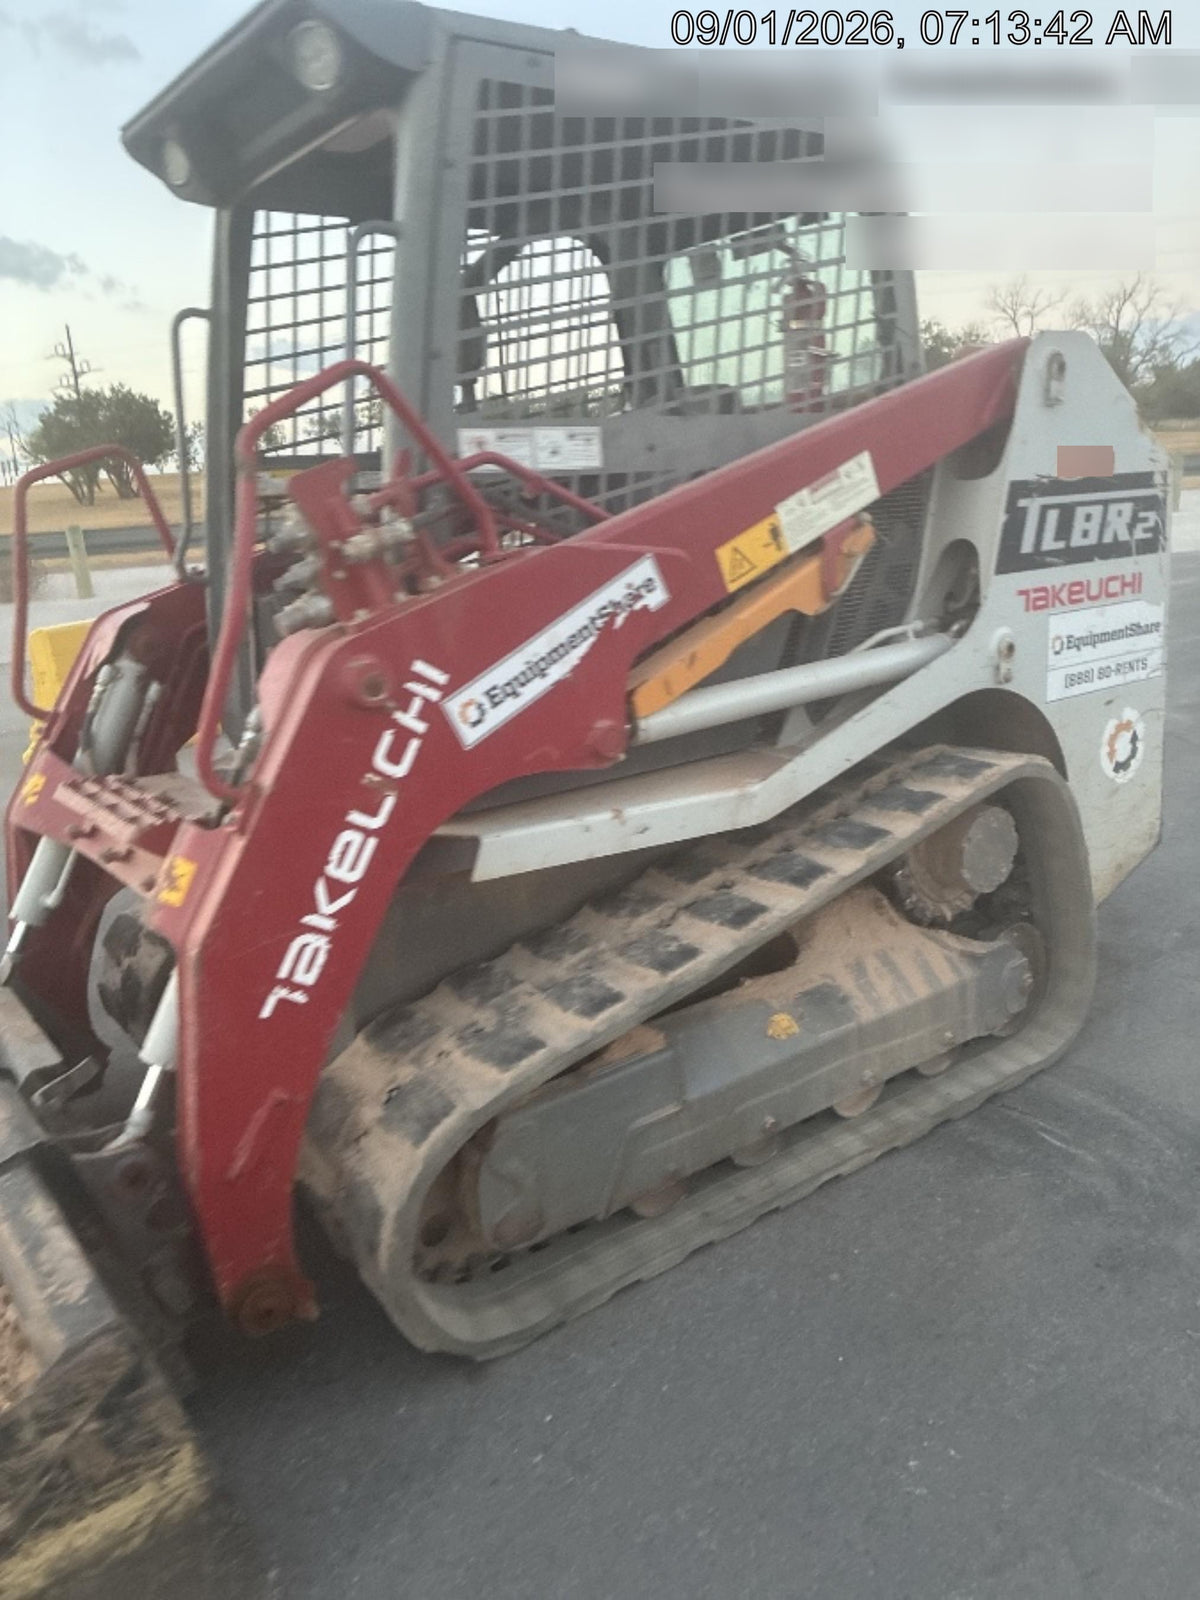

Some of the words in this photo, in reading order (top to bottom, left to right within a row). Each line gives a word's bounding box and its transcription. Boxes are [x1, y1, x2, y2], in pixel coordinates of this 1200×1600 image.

[1017, 488, 1160, 554] TL8R2
[1016, 572, 1142, 612] TAKEUCHI
[1066, 622, 1161, 651] EquipmentShare
